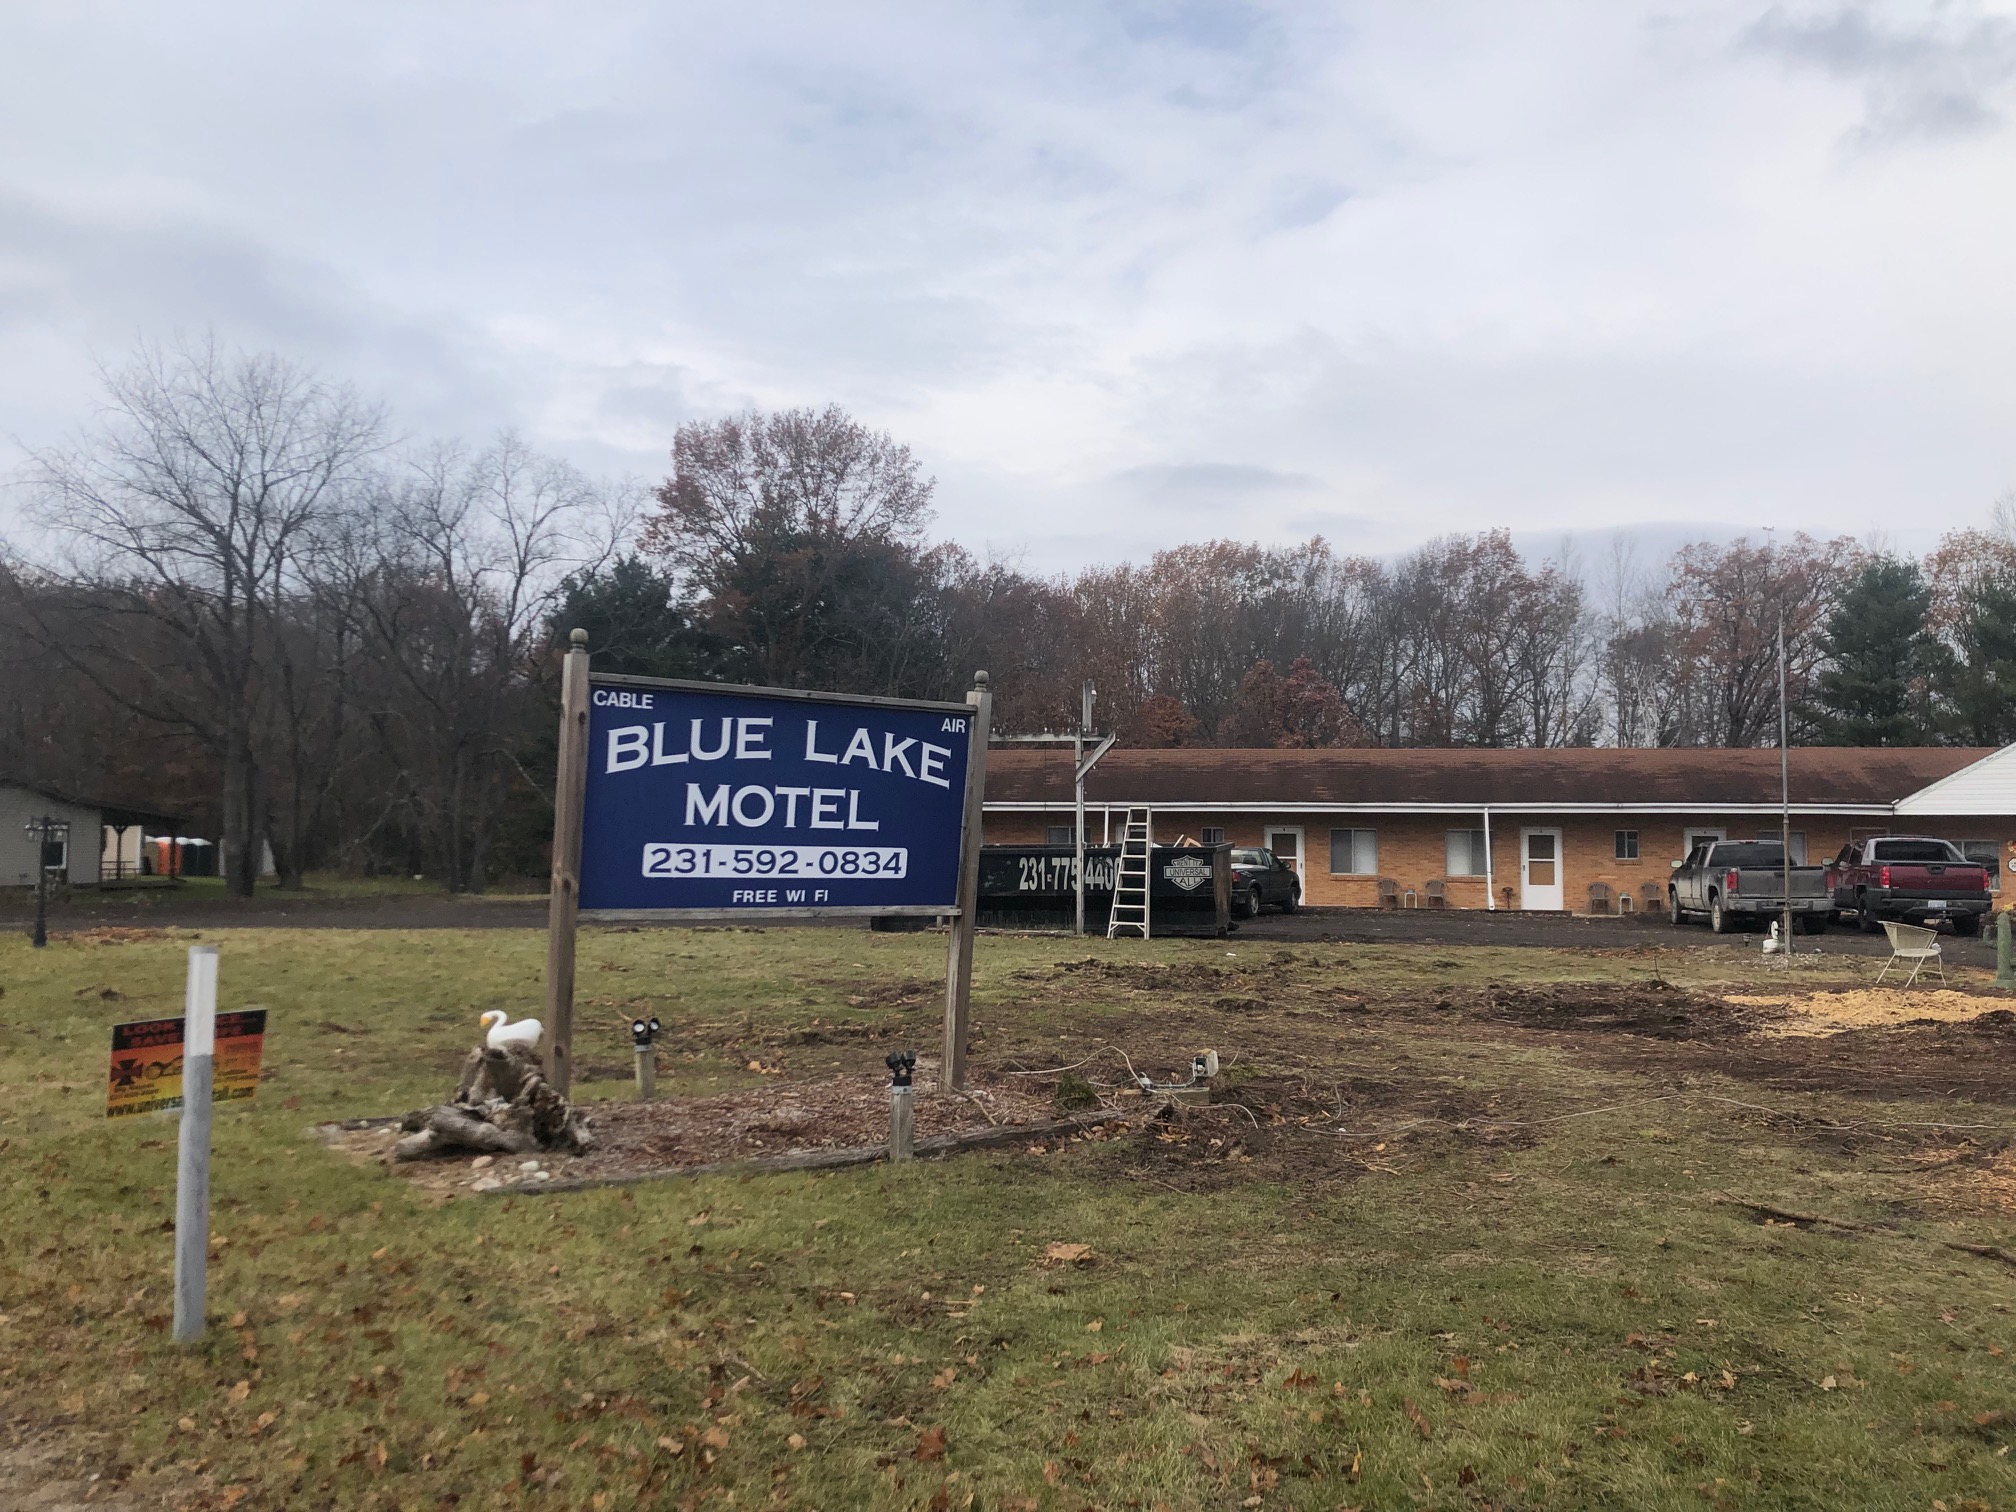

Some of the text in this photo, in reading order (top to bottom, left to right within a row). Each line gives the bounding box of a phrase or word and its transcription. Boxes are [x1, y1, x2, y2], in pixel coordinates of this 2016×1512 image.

[592, 690, 654, 710] CABLE
[941, 718, 966, 734] AIR
[604, 716, 952, 790] BLUE LAKE
[684, 783, 880, 832] MOTEL
[648, 847, 903, 876] 231-592-0834
[1169, 868, 1207, 876] UNIVERSAL
[1179, 877, 1200, 887] ALL
[732, 889, 829, 903] FREE WI FI
